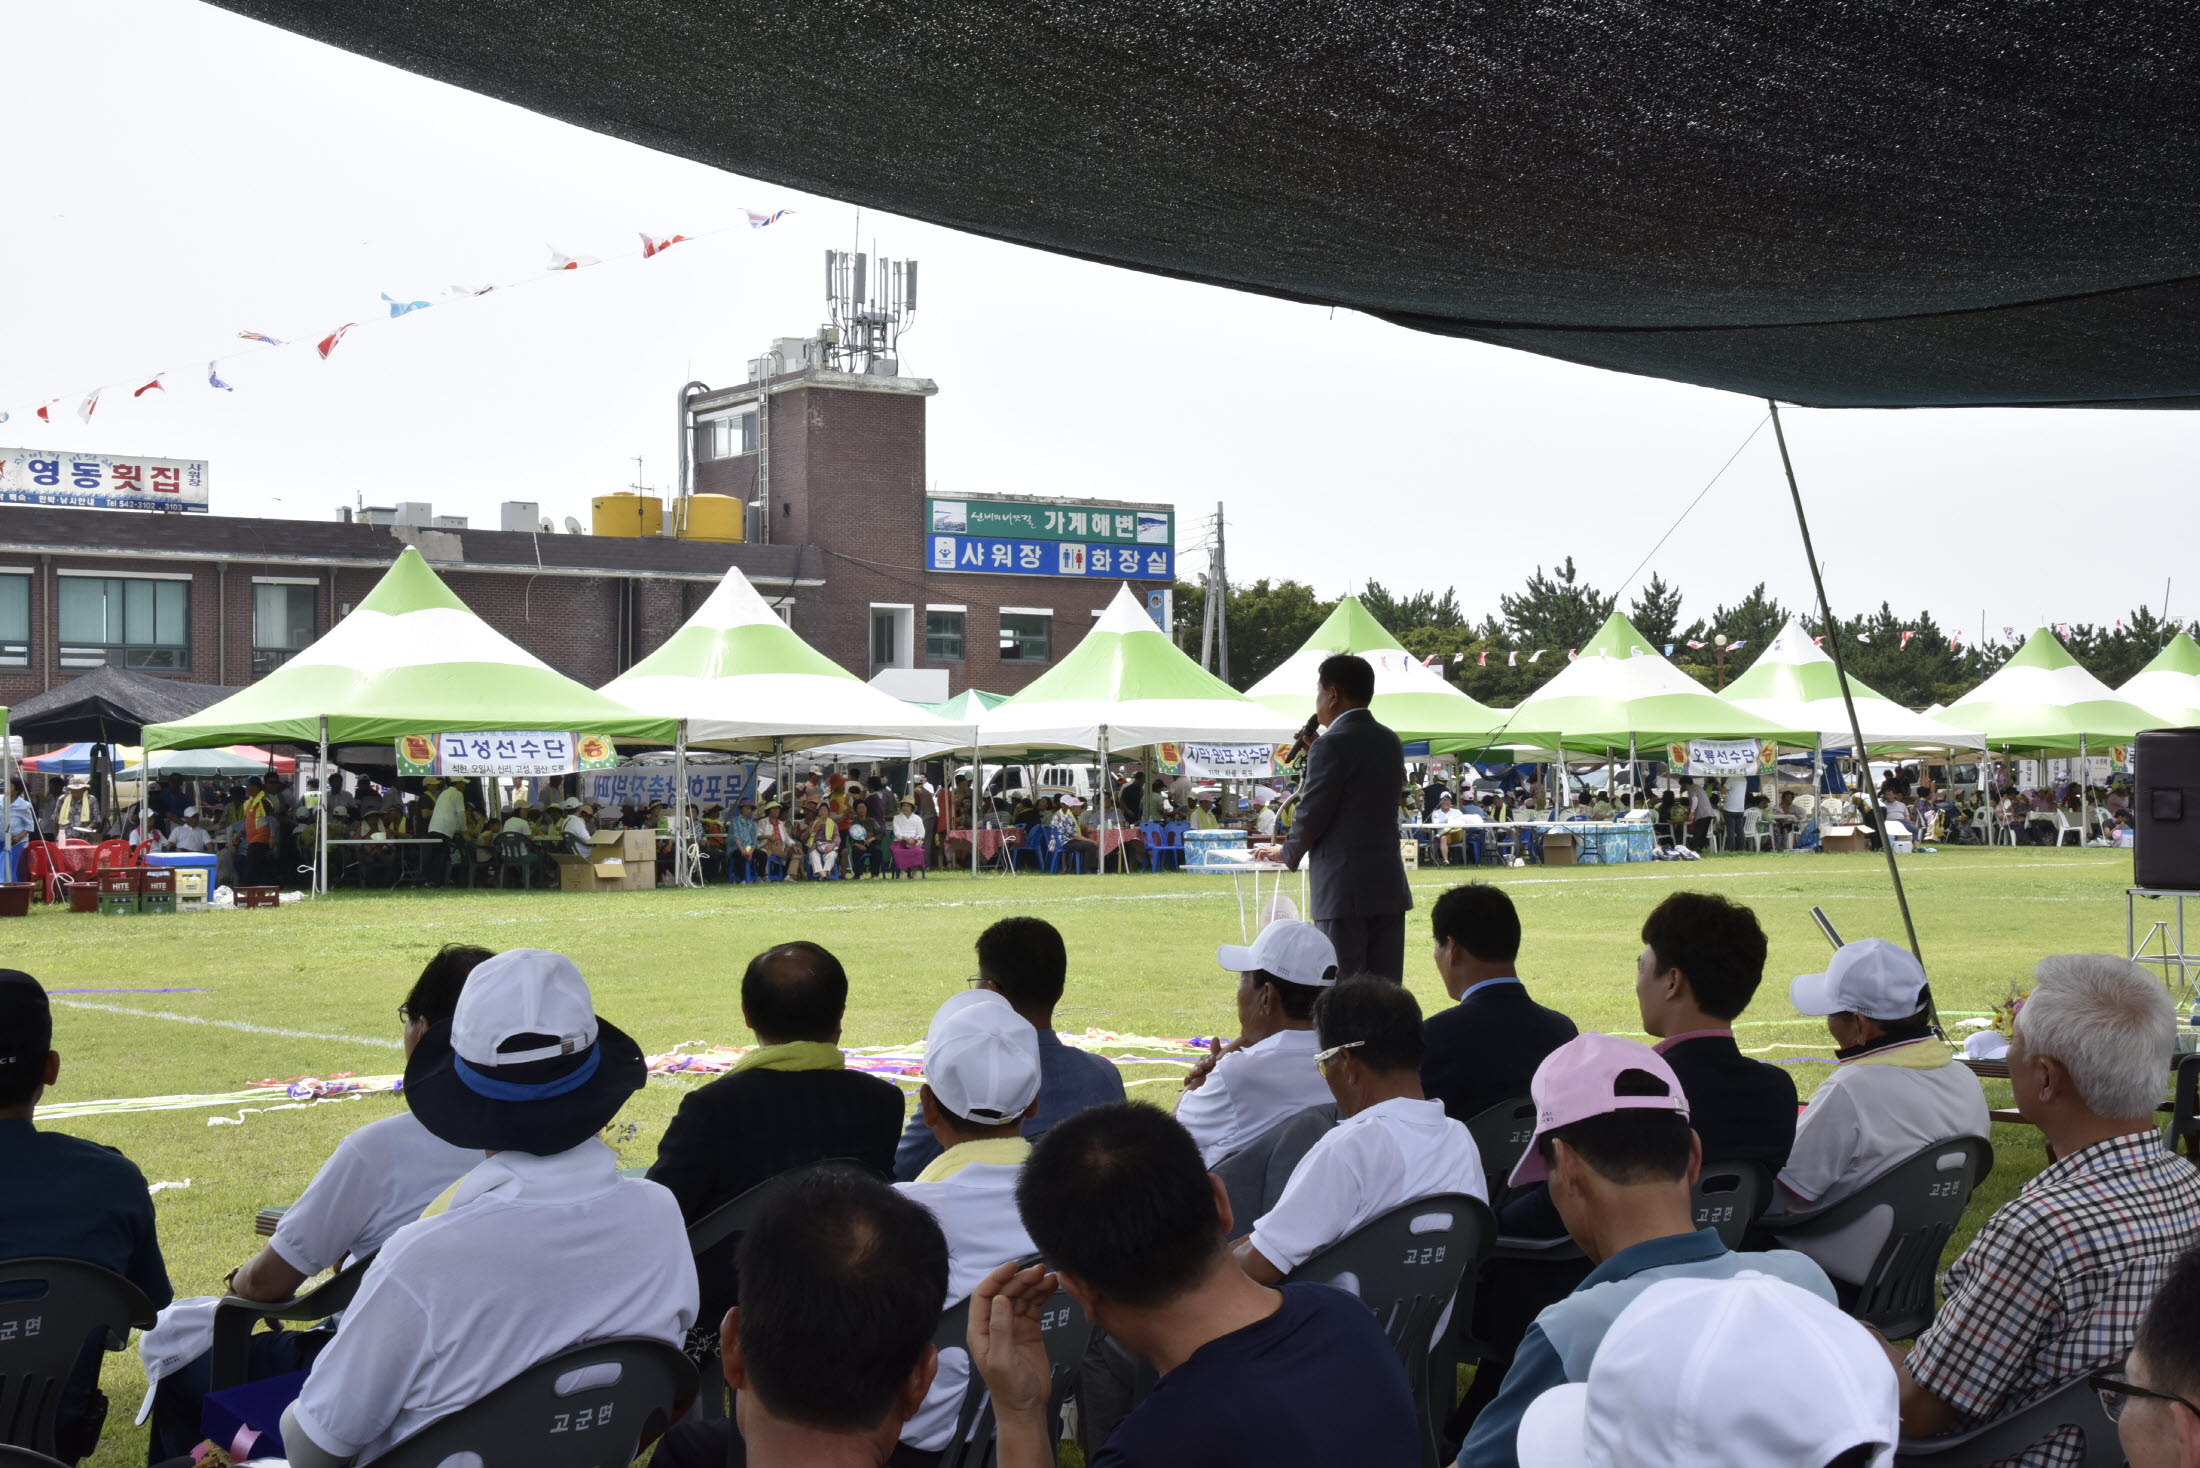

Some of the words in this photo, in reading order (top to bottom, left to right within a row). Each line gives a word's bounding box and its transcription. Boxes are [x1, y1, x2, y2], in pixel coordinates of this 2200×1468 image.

[106, 499, 117, 507] Tel
[164, 503, 183, 511] 3103
[1043, 510, 1135, 539] 가계해변
[960, 542, 1043, 569] 샤워장
[1091, 548, 1168, 575] 화장실
[446, 738, 565, 760] 고성선수단
[583, 740, 603, 758] 승
[1238, 747, 1271, 764] 선수단
[1692, 748, 1755, 765] 오룡선수단
[112, 882, 130, 890] HITE
[1510, 1130, 1531, 1143] 고군
[1928, 1179, 1960, 1197] 고군면
[1696, 1206, 1734, 1223] 고군면
[1403, 1245, 1447, 1265] 고군면
[1040, 1306, 1071, 1331] 군면
[549, 1402, 614, 1434] 고군면
